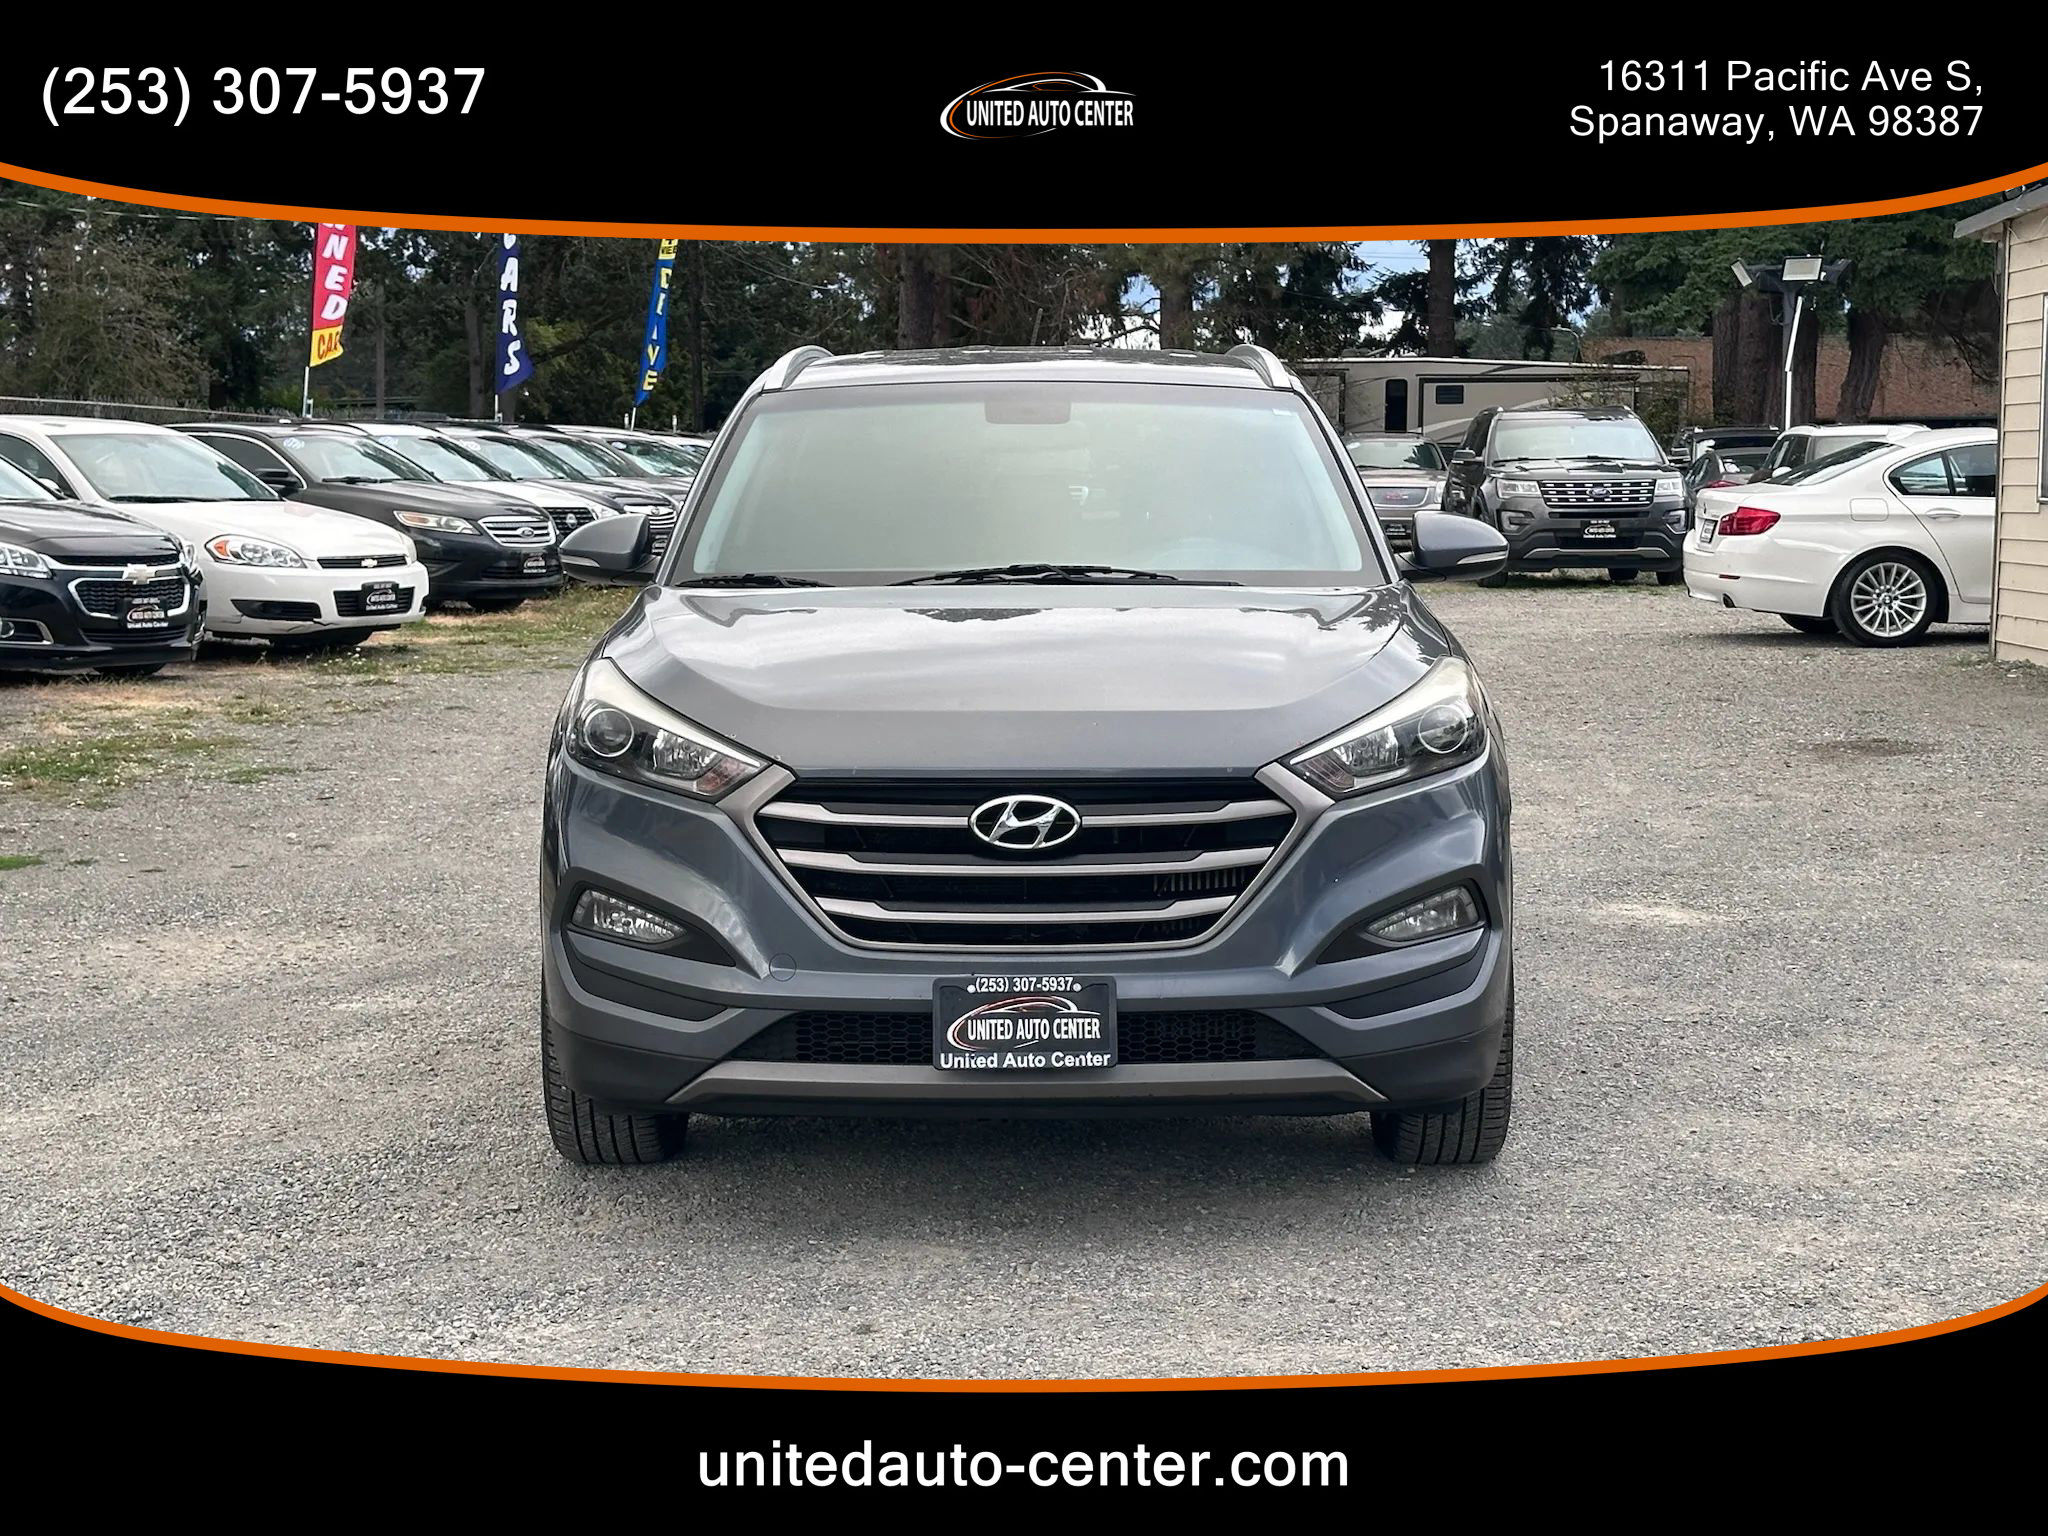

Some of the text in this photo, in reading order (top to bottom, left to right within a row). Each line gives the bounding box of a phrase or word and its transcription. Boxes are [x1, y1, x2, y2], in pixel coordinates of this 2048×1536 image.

[320, 223, 349, 321] NED
[975, 976, 1074, 993] (253) 307-5937
[967, 1017, 1101, 1041] UNITED AUTO CENTER
[940, 1051, 1111, 1069] United Auto Center
